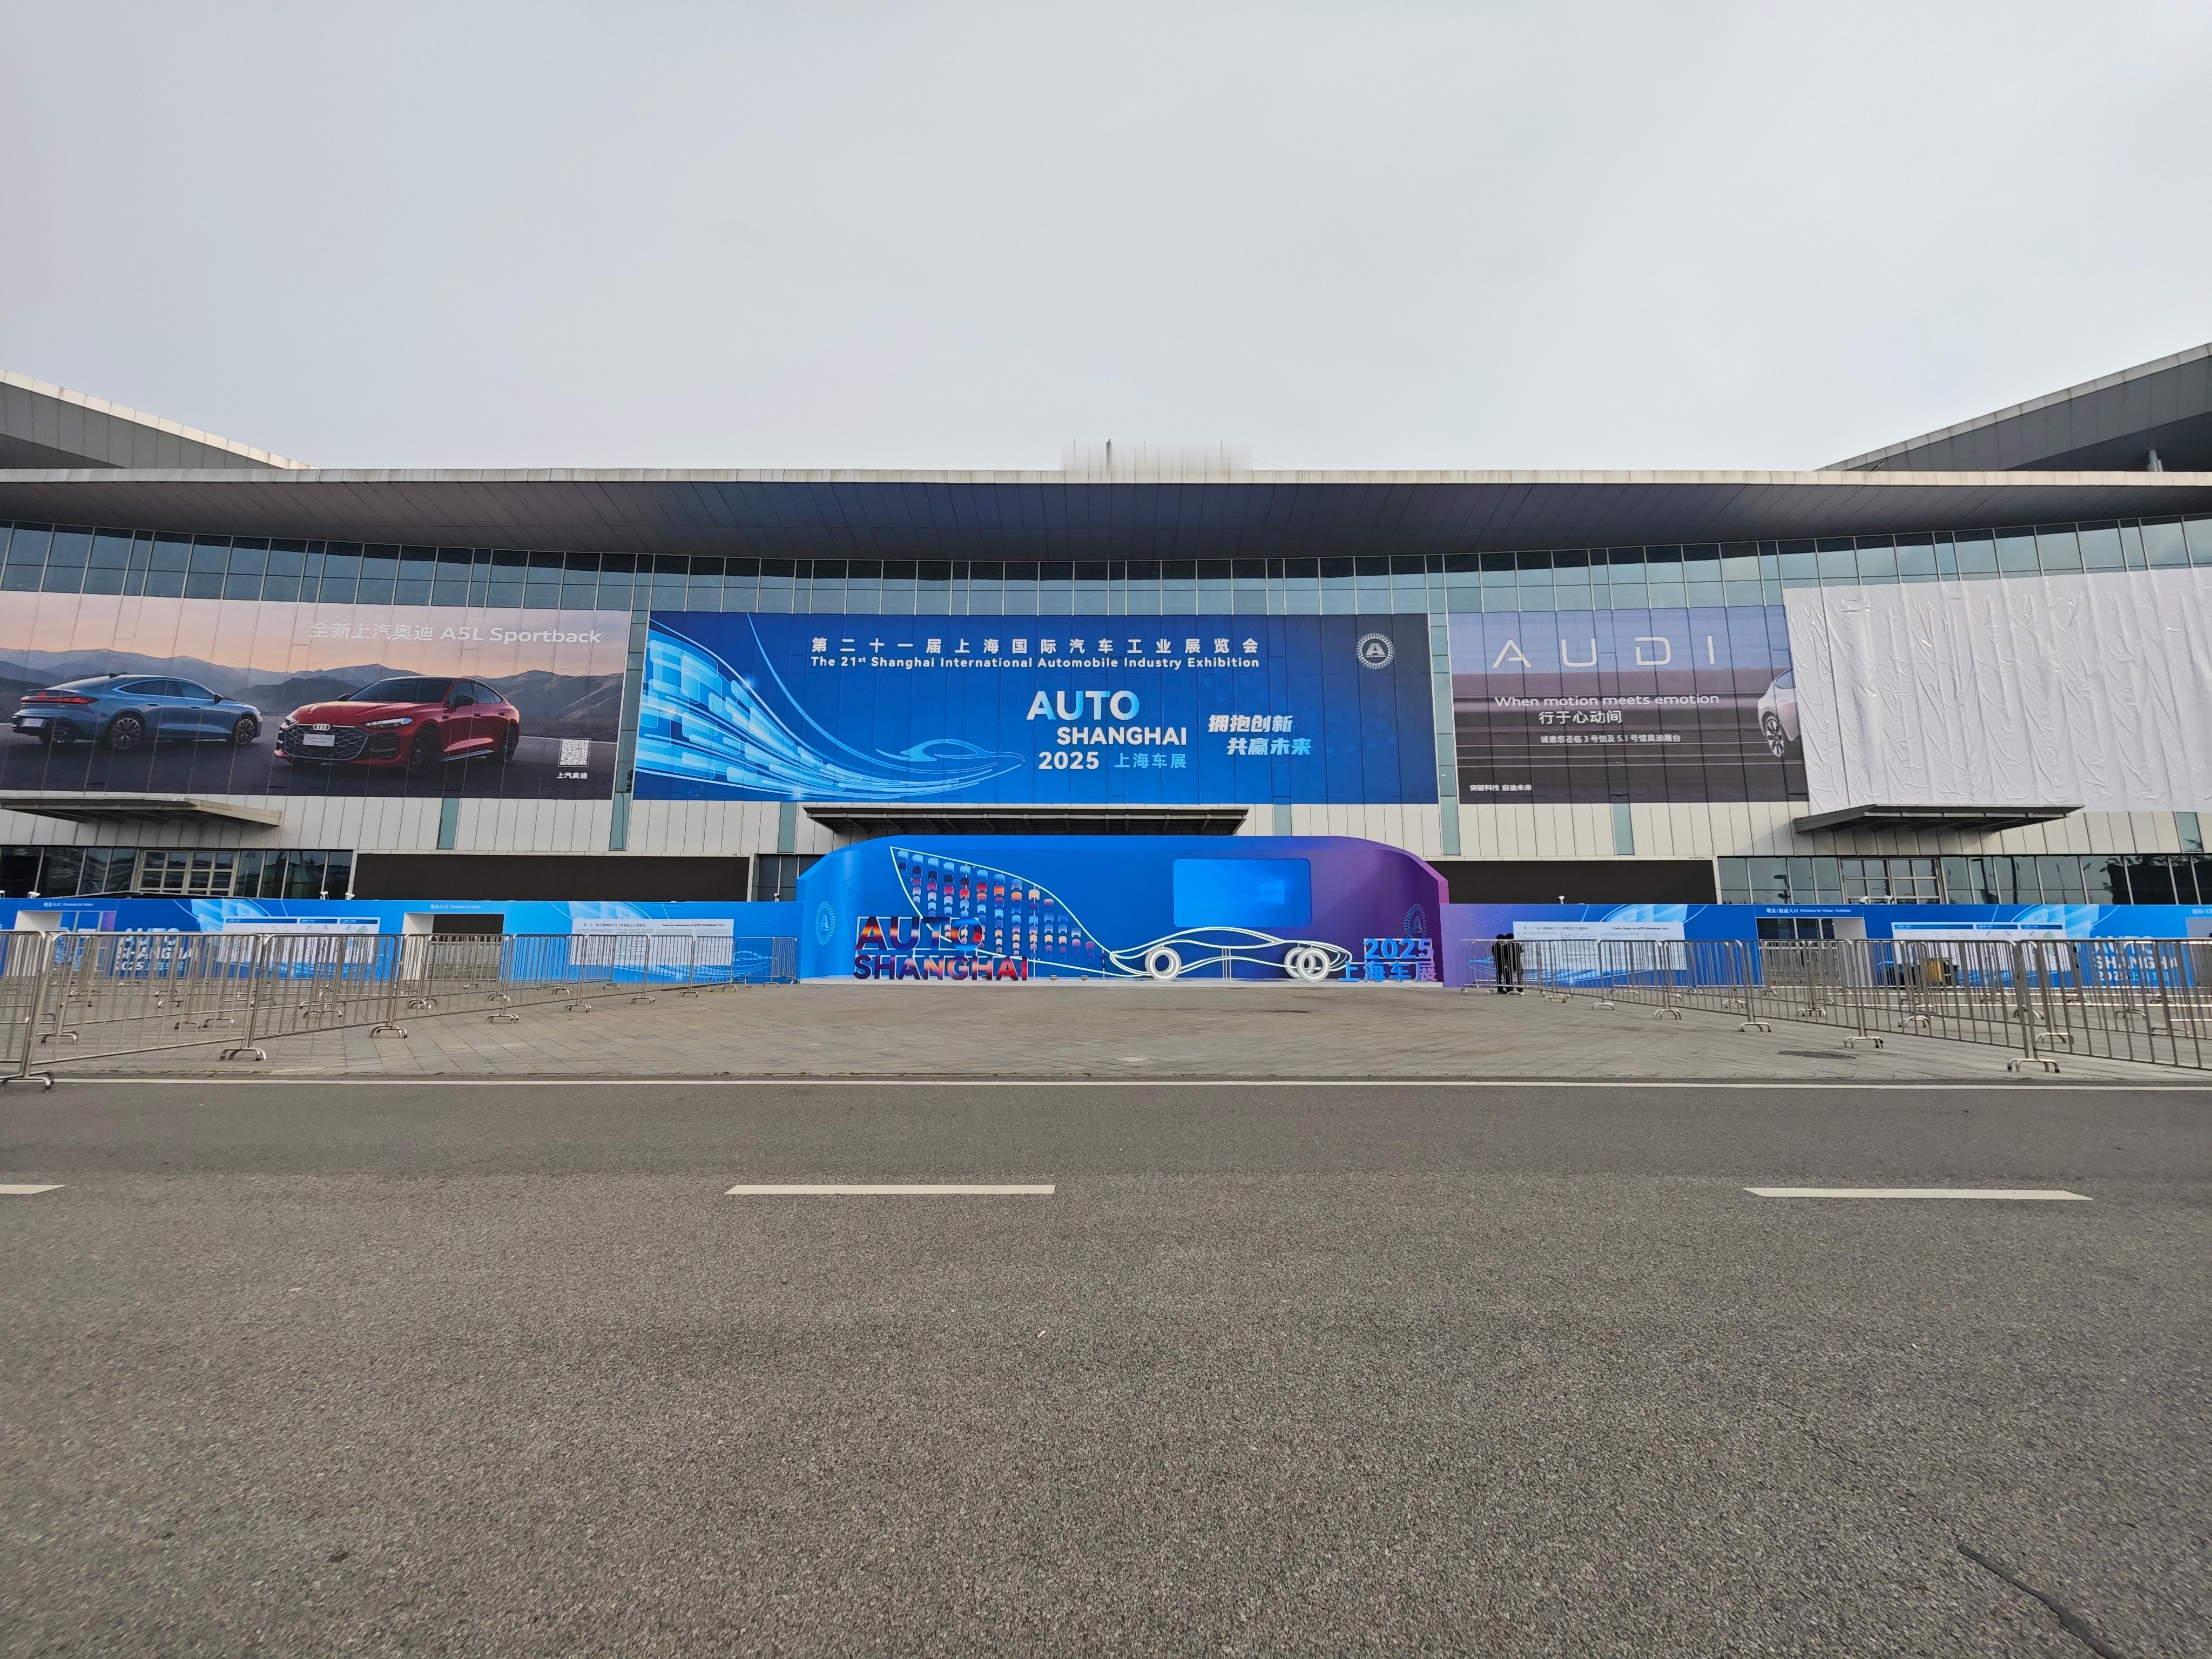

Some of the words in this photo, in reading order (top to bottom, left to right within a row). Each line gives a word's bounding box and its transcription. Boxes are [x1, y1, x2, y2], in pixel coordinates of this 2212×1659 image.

[309, 622, 433, 640] 全新上汽奥迪
[439, 626, 483, 641] A5L
[489, 628, 602, 645] Sportback
[812, 637, 1258, 654] 第二十一届上海国际汽车工业展览会
[1492, 636, 1715, 668] AUDI
[811, 657, 835, 666] The
[871, 657, 935, 670] Shanghai
[941, 657, 1032, 667] International
[1037, 657, 1118, 667] Automobile
[1124, 657, 1182, 670] Industry
[1188, 657, 1259, 667] Exhibition
[1026, 690, 1139, 720] AUTO
[1494, 696, 1539, 707] When
[1543, 696, 1599, 706] motion
[1603, 695, 1651, 706] meets
[1655, 694, 1720, 704] emotion
[1208, 714, 1293, 733] 拥抱创新
[1539, 710, 1623, 725] 行于心动间
[1056, 727, 1186, 745] SHANGHAI
[1226, 738, 1312, 756] 共赢未来
[1038, 751, 1100, 770] 2025
[1114, 753, 1186, 768] 上海车展
[855, 916, 983, 951] AUTO
[1364, 938, 1434, 959] 2025
[853, 955, 1028, 981] SHANGHAI
[1338, 960, 1437, 982] 上海车展
